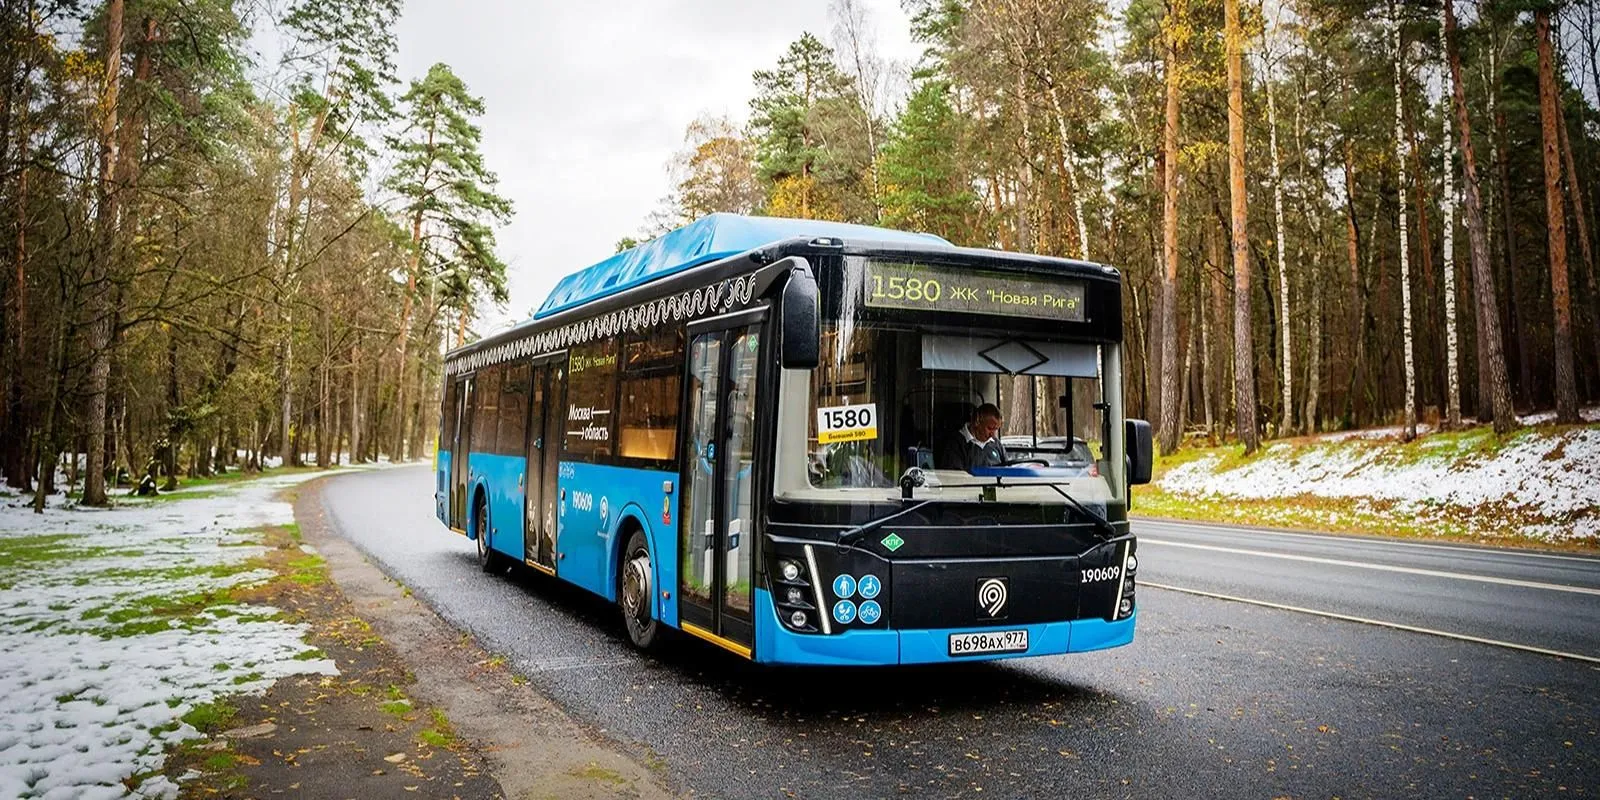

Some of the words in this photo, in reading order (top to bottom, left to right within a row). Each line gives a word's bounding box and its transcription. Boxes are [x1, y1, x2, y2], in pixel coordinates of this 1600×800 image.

[871, 275, 941, 302] 1580
[950, 286, 978, 301] ЖК
[986, 290, 1037, 307] "Новая
[1043, 295, 1080, 310] Рига"
[568, 403, 590, 420] Москва
[824, 408, 871, 429] 1580
[584, 422, 609, 440] область
[572, 491, 593, 512] 190609
[1081, 566, 1120, 583] 190609
